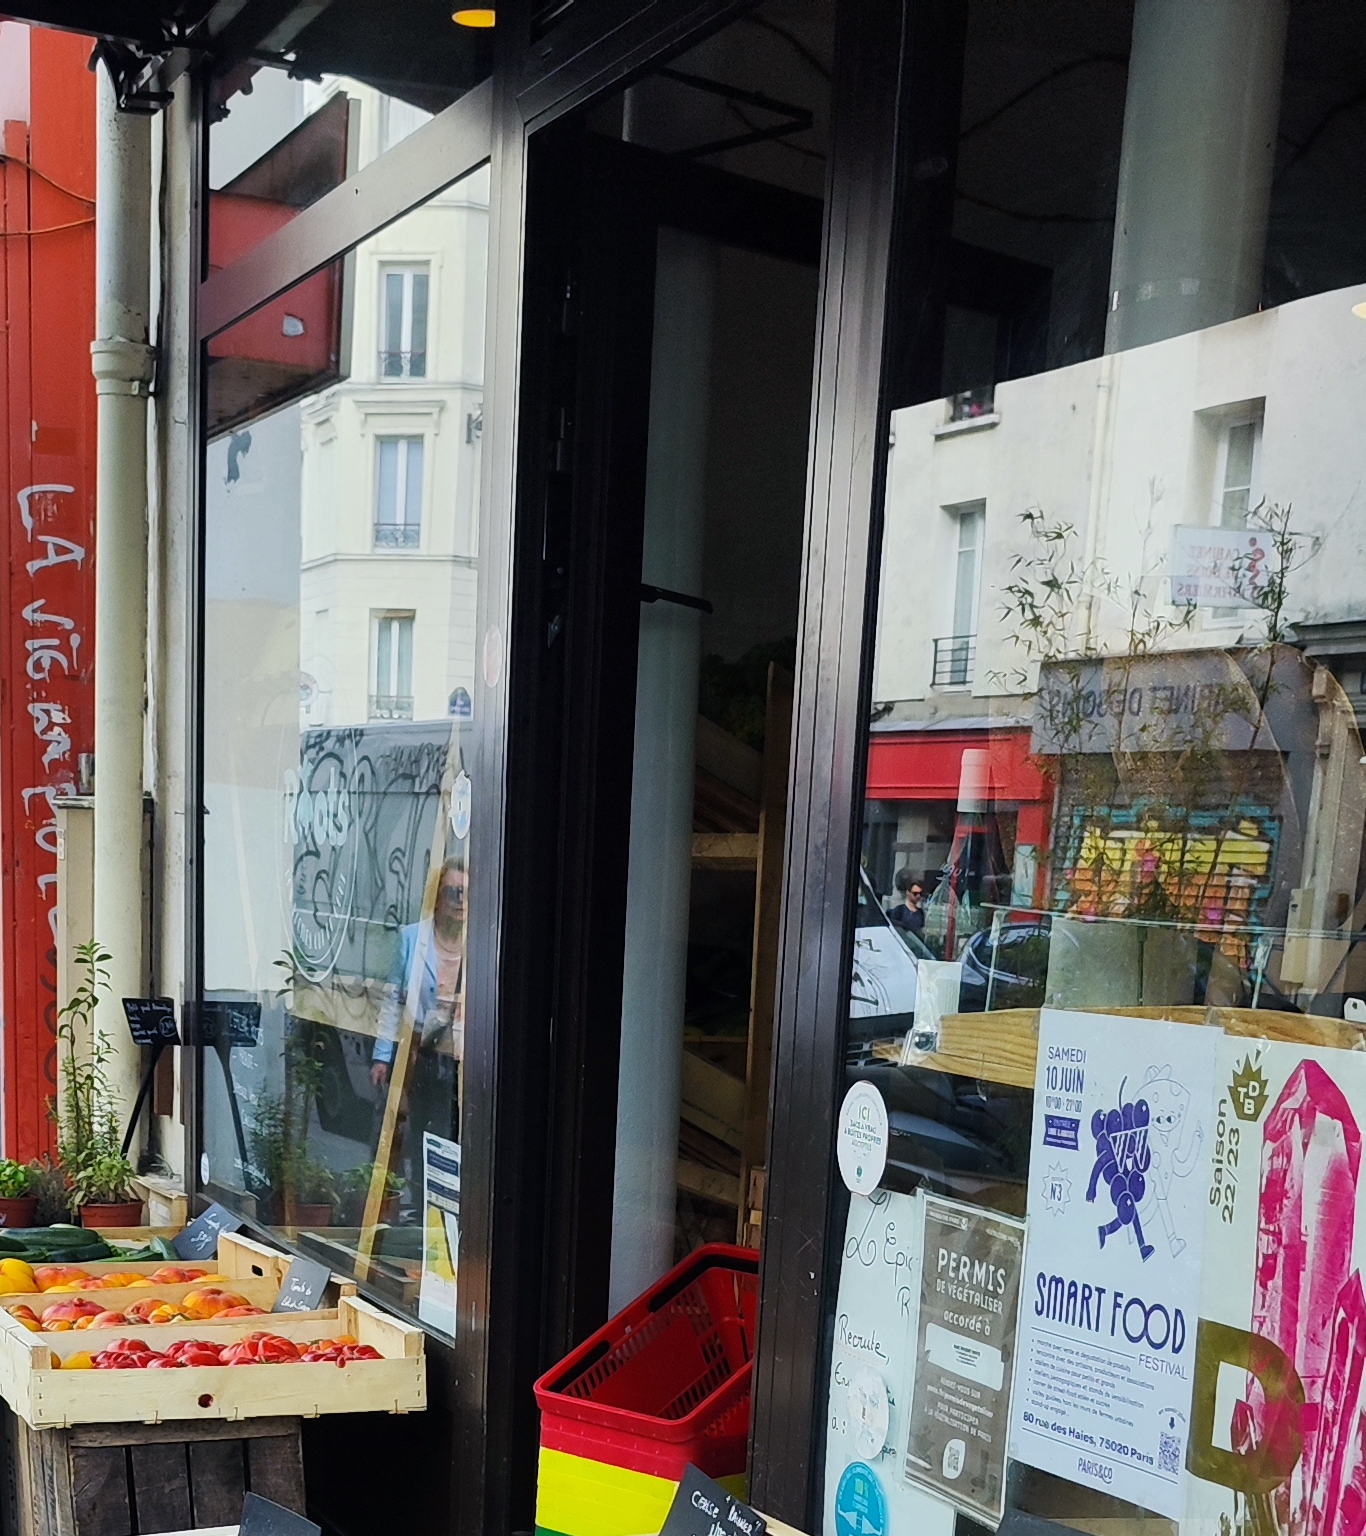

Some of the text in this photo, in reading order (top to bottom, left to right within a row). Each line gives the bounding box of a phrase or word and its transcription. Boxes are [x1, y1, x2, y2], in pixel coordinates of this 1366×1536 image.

[1047, 1045, 1087, 1064] SAMEDI
[1045, 1065, 1085, 1095] 10 JUIN
[859, 1105, 870, 1121] ICI
[1208, 1098, 1229, 1208] Saison
[1223, 1126, 1241, 1225] 22/23
[937, 1247, 1006, 1295] PERMIS
[936, 1278, 1003, 1315] DE VÉGÉTALISER
[1034, 1271, 1186, 1356] SMART FOOD
[943, 1310, 983, 1333] accordé
[1138, 1353, 1188, 1380] FESTIVAL
[1035, 1417, 1050, 1429] rue
[1050, 1421, 1067, 1435] des
[1099, 1436, 1129, 1456] 75020
[1130, 1448, 1154, 1466] Paris
